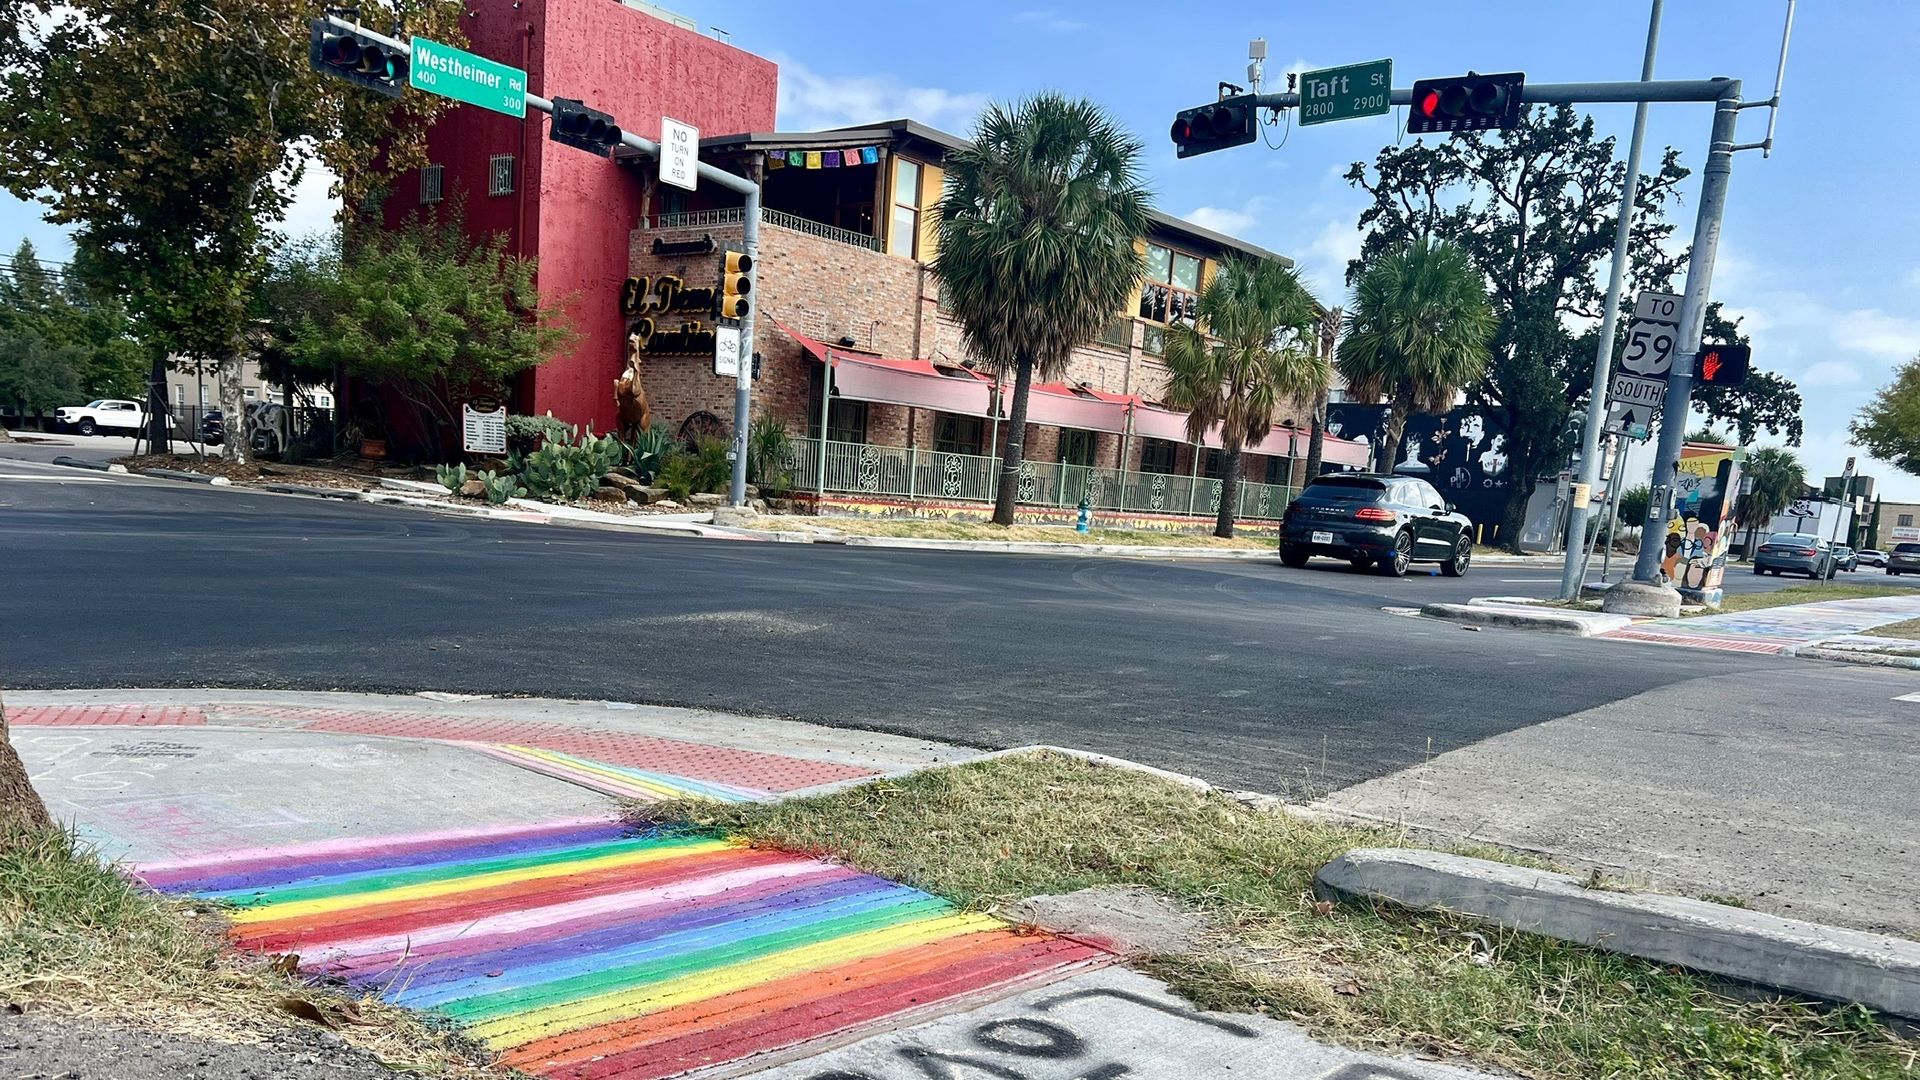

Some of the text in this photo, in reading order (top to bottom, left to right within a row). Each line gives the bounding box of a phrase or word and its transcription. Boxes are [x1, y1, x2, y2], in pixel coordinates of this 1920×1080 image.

[416, 45, 522, 92] Westheimer Rd
[416, 72, 521, 111] 400 300
[1306, 73, 1384, 99] Taft St
[1305, 94, 1384, 117] 2800 2900
[672, 130, 688, 142] NO
[671, 144, 690, 156] TURN
[674, 158, 685, 168] ON
[671, 169, 686, 180] RED
[1651, 298, 1675, 316] TO
[1626, 332, 1673, 365] 59
[718, 356, 737, 366] SIGNAL
[1615, 382, 1661, 402] SOUTH
